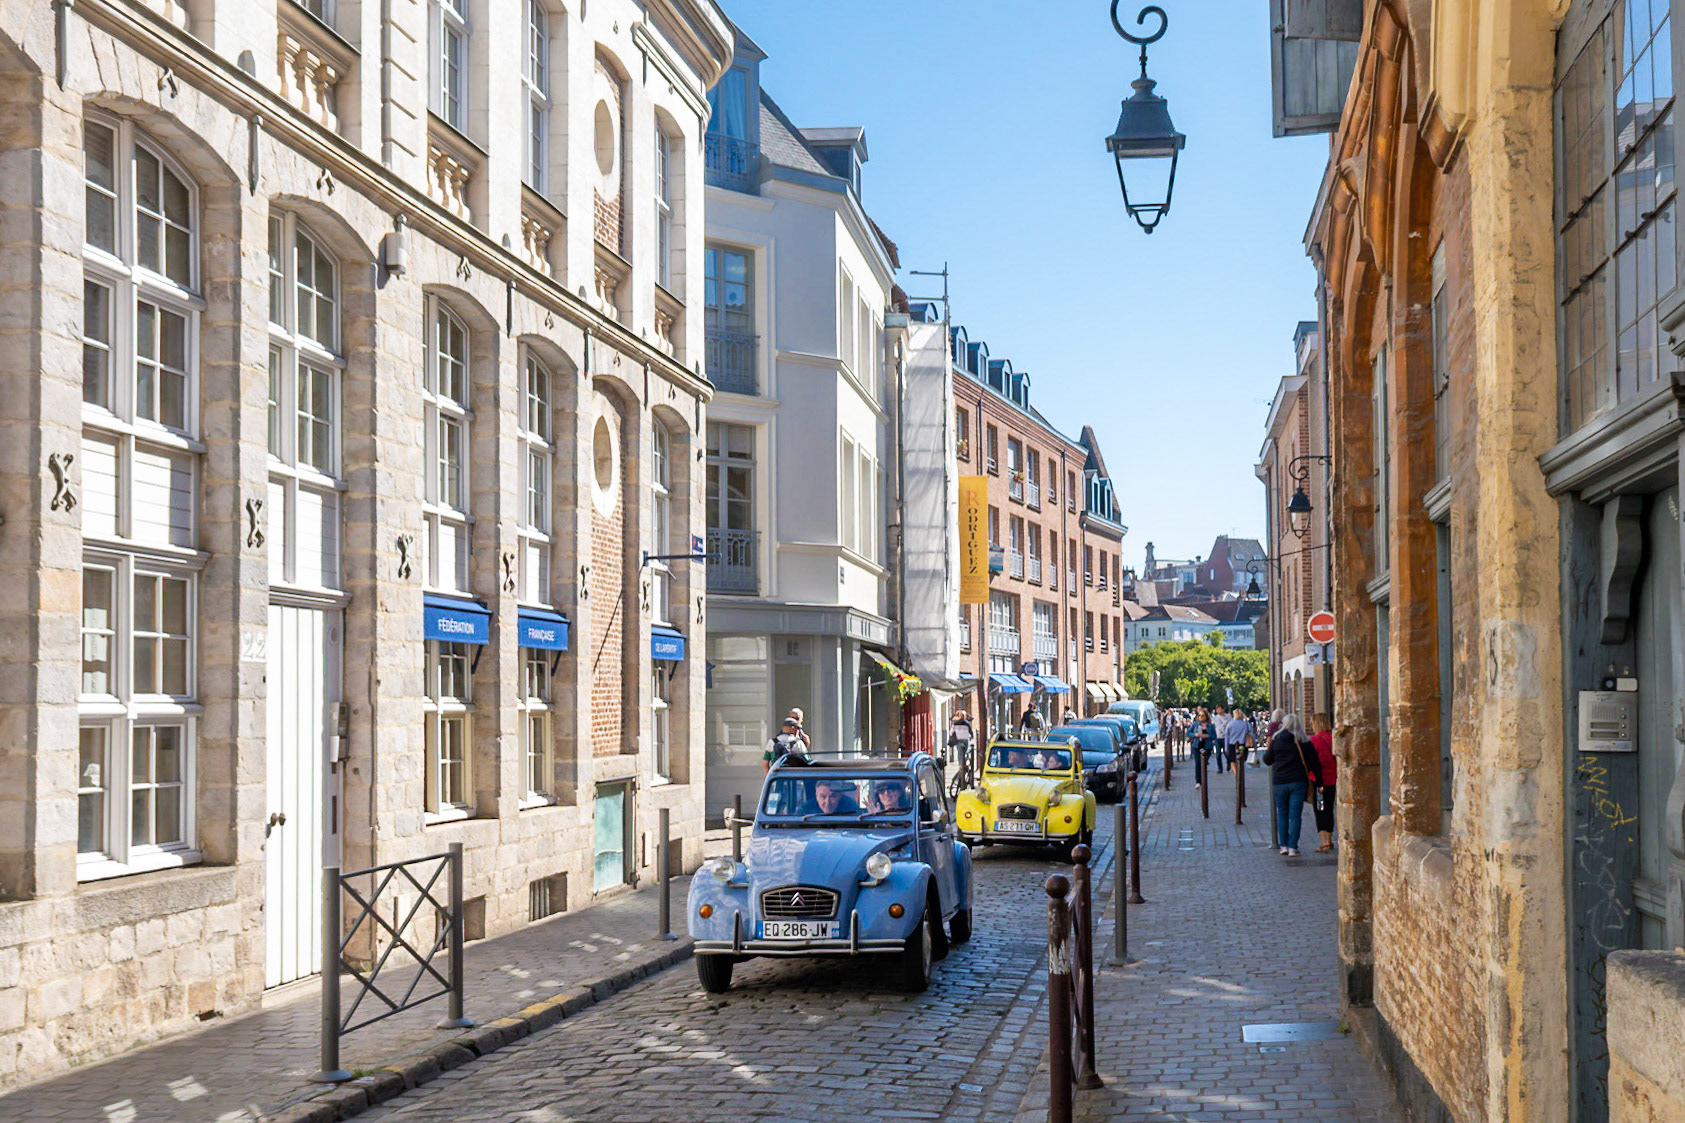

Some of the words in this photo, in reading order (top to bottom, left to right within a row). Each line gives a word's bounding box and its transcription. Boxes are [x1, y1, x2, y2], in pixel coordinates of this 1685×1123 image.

[438, 617, 474, 635] FÉDÉRATION
[528, 627, 555, 643] FRANÇAISE
[243, 630, 266, 660] 22
